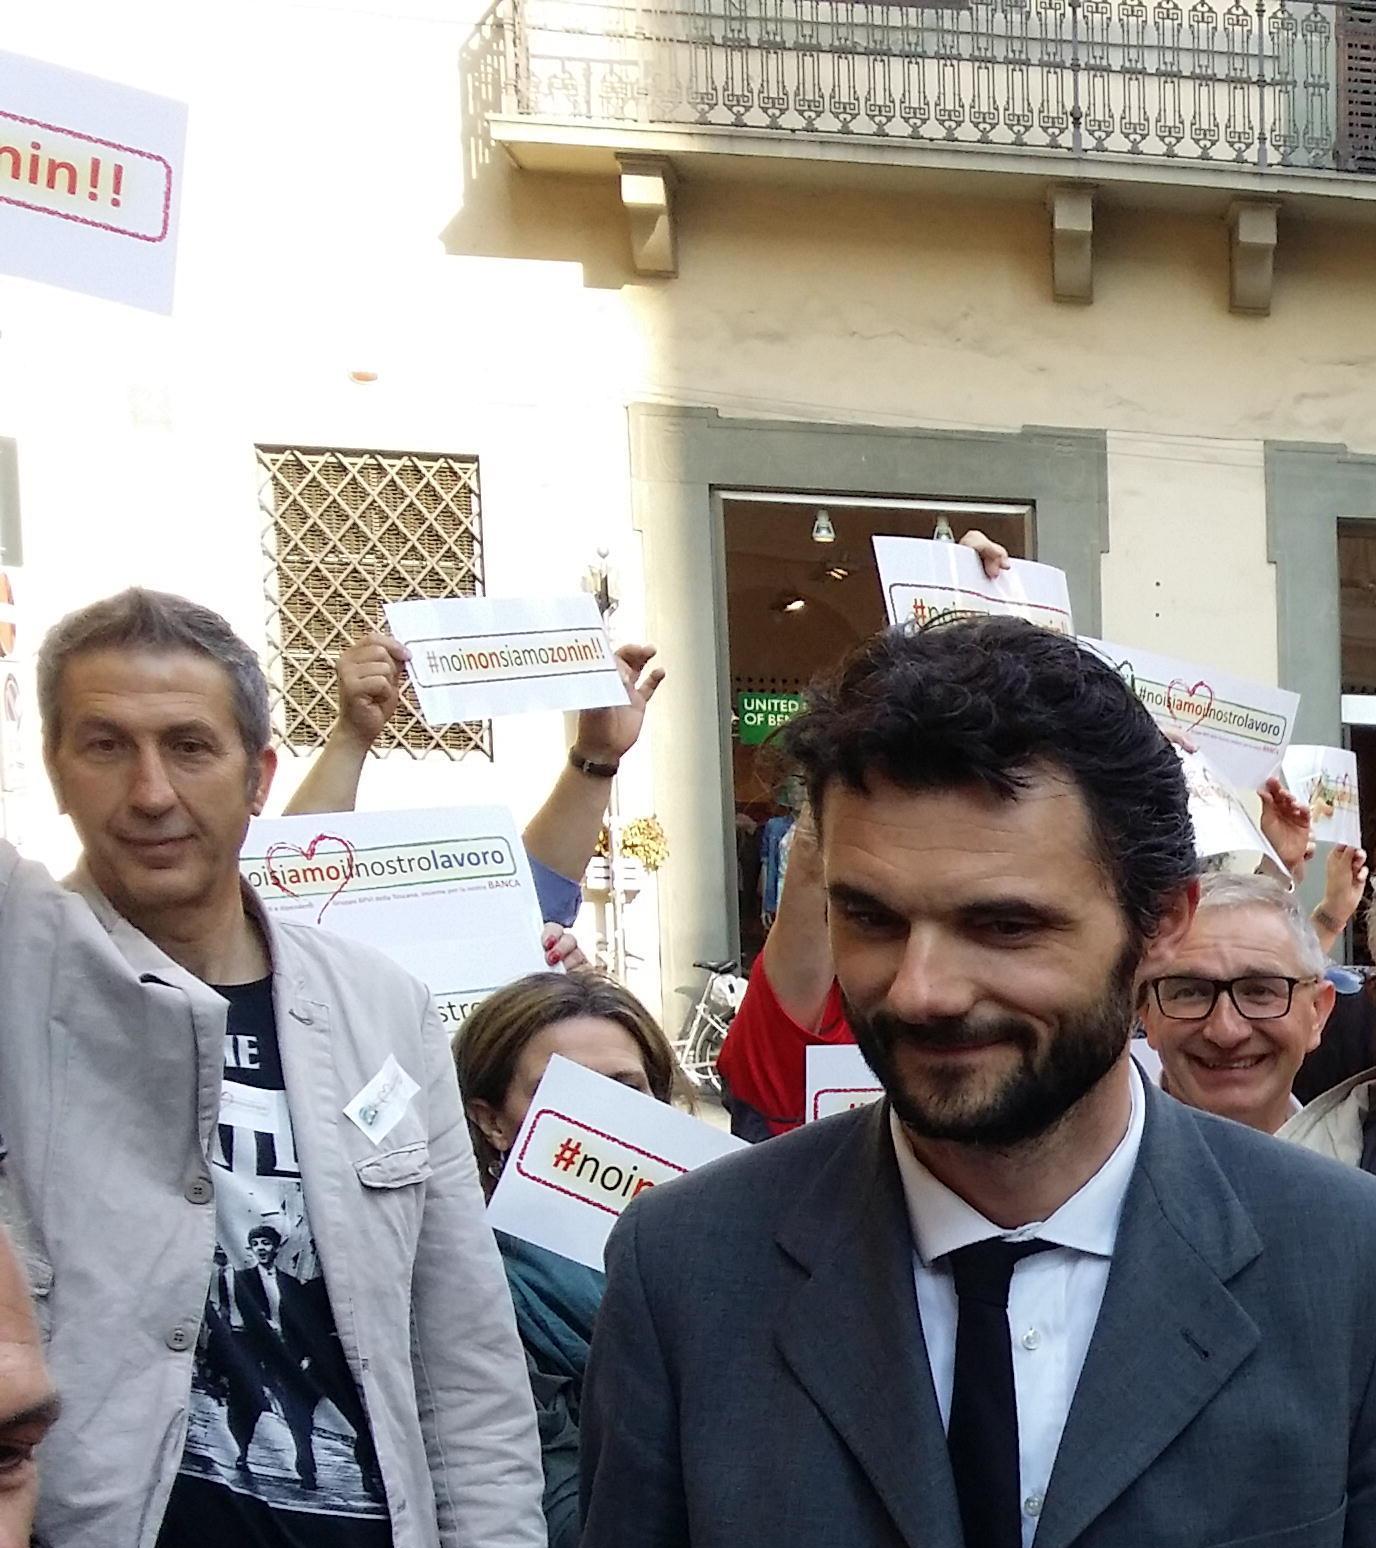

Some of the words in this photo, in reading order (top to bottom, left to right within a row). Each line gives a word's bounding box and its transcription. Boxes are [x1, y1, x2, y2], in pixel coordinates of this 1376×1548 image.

[427, 637, 605, 673] #noinonsiamozonin!!
[743, 698, 799, 712] UNITED
[744, 713, 765, 726] OF
[488, 878, 521, 889] BANCA
